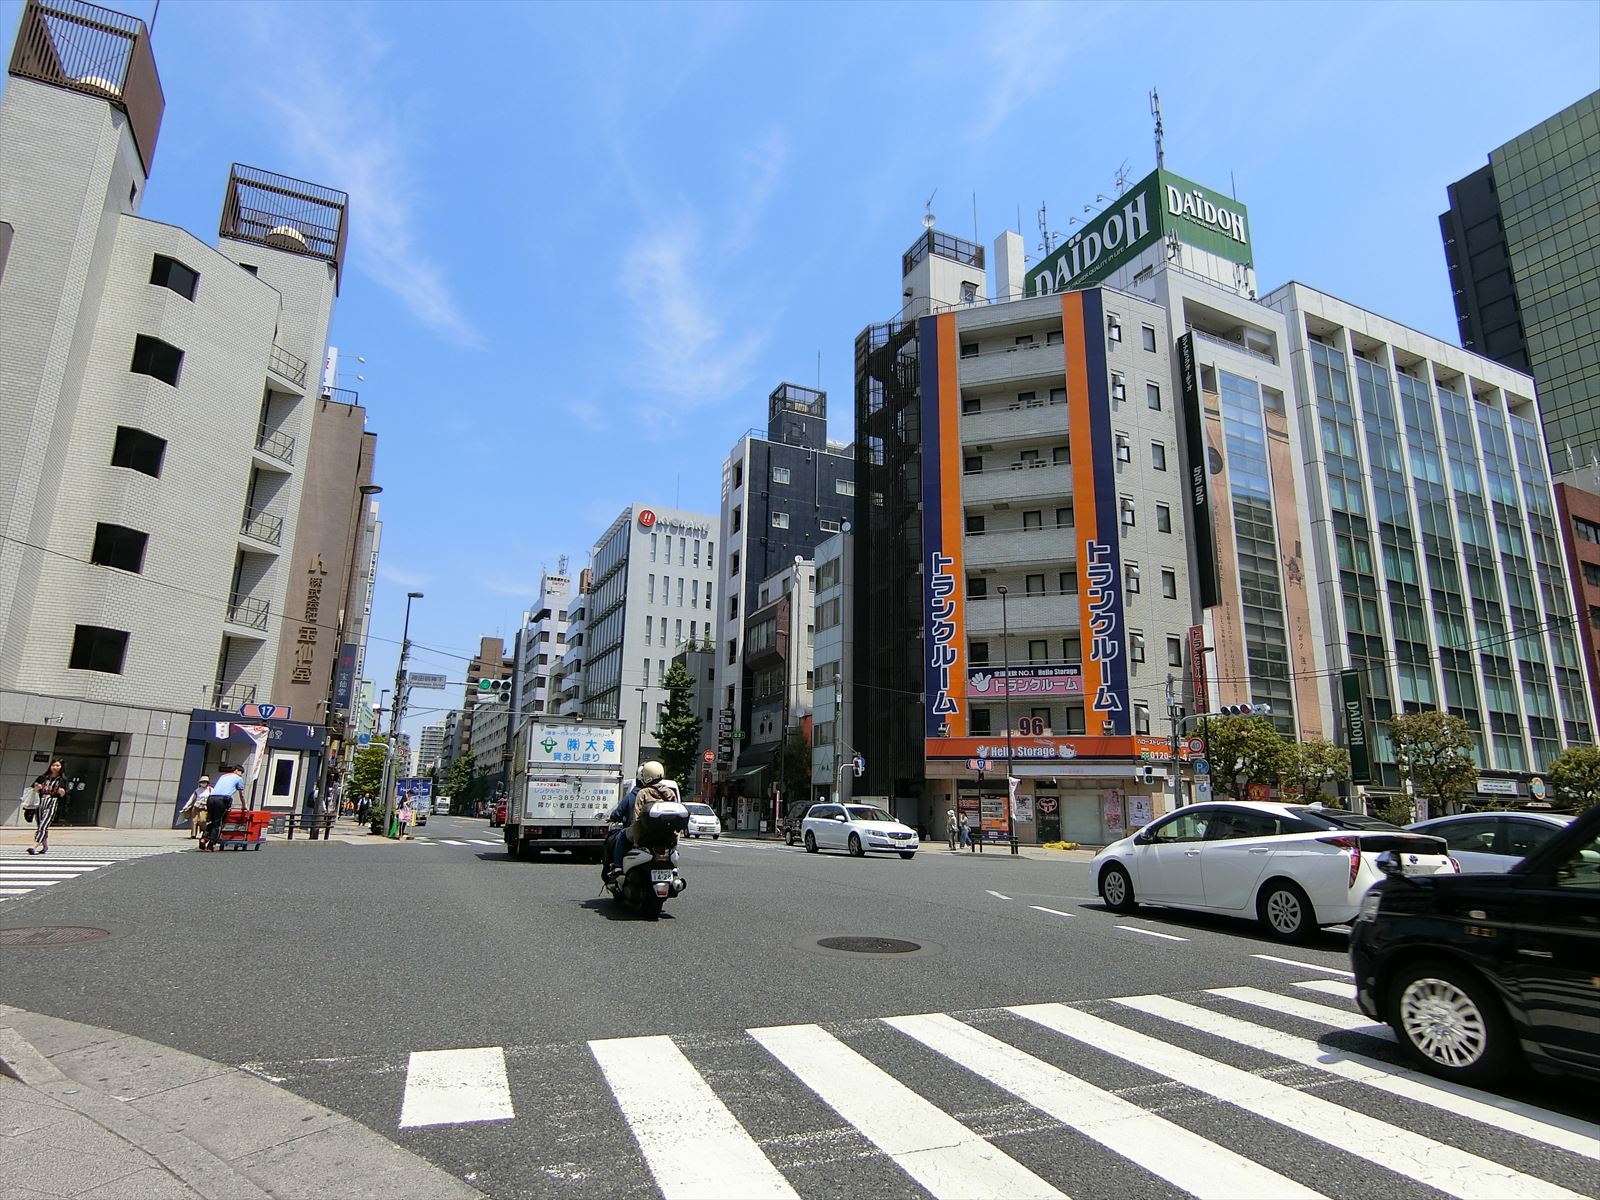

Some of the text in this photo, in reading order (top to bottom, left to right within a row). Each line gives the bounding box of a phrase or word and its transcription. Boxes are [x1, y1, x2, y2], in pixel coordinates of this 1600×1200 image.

[1166, 184, 1247, 245] DAÏDOH
[931, 552, 959, 714] トランクルーム
[1086, 540, 1122, 711] トランクルーム
[995, 678, 1078, 692] トランクルーム
[261, 706, 273, 716] 17
[1019, 717, 1044, 736] 96
[1346, 701, 1364, 746] DAÏDOH
[553, 752, 600, 762] 貸おしぼり
[1017, 746, 1055, 758] Storage
